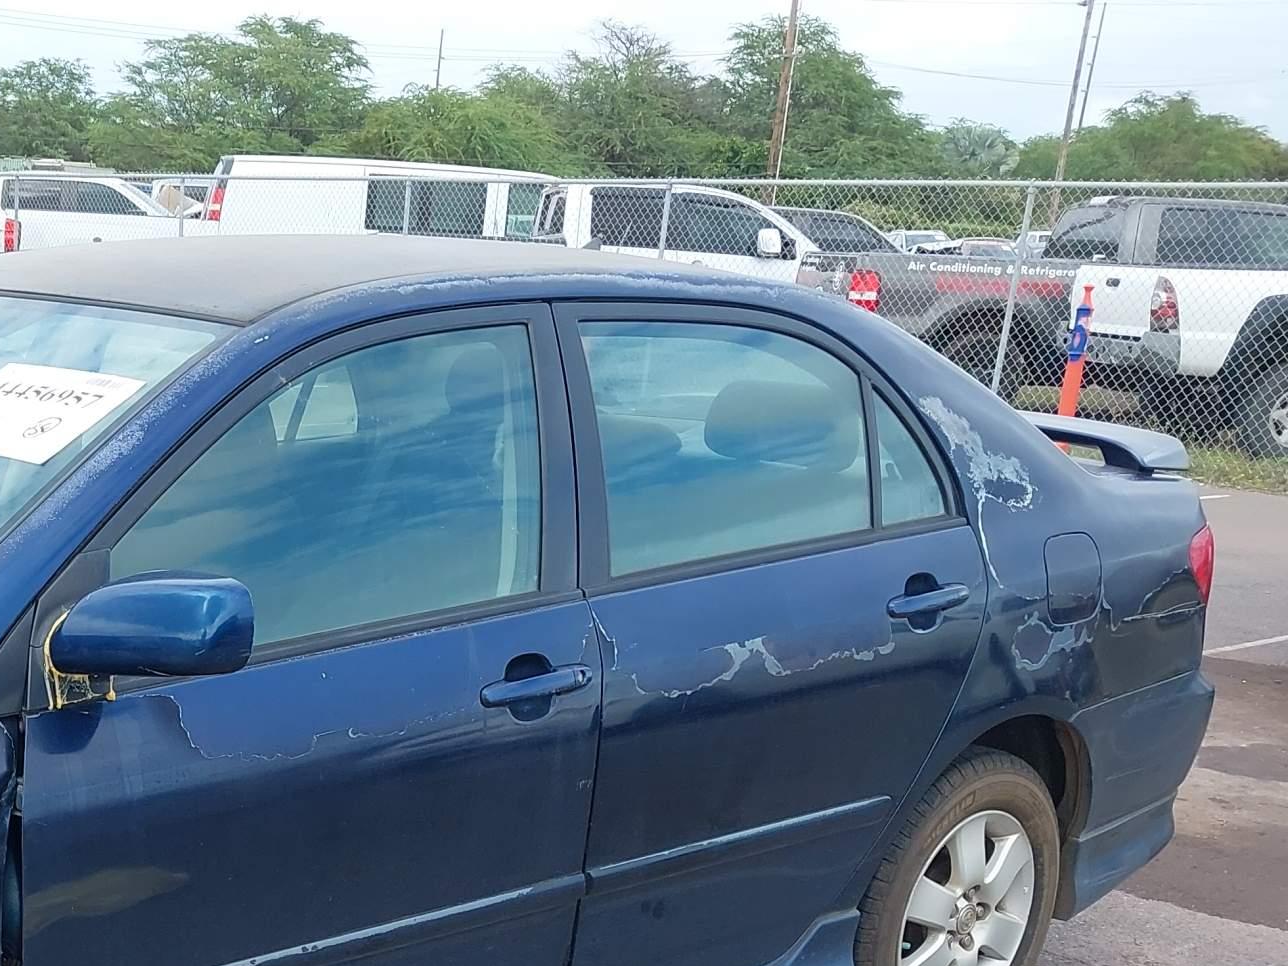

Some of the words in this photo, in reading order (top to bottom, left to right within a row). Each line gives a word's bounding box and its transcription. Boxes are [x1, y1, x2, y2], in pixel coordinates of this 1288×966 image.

[907, 262, 925, 272] Air
[929, 262, 1002, 275] Conditioning
[1006, 265, 1015, 274] &
[1020, 265, 1078, 279] Refrigera
